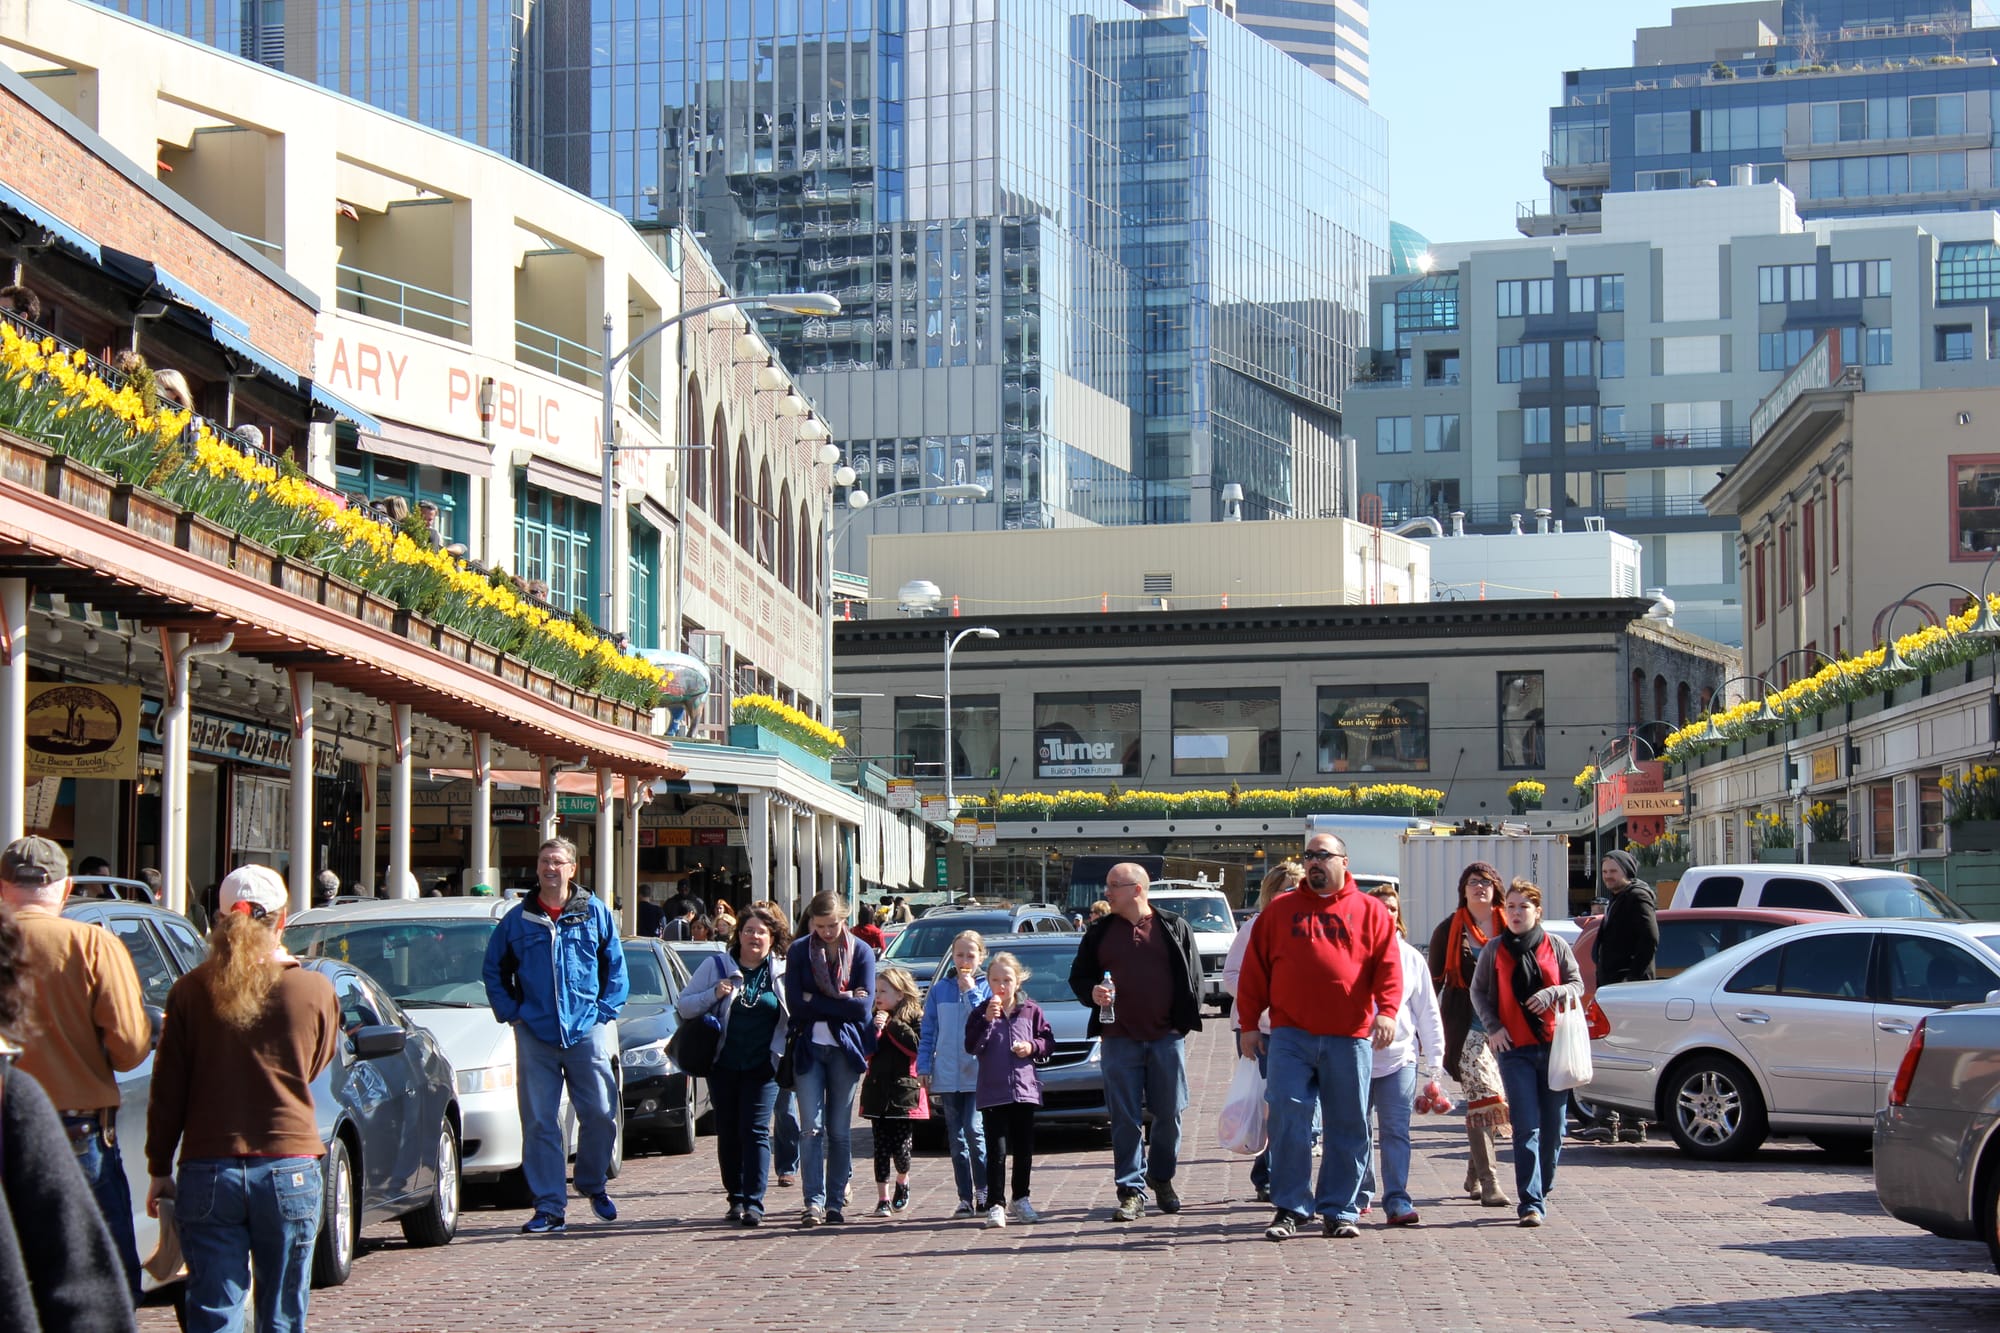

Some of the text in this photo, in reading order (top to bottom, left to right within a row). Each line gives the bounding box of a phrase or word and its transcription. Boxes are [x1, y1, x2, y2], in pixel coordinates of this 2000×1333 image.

[448, 367, 561, 446] PUBLIC
[239, 725, 345, 777] DELIIES
[1043, 738, 1115, 761] Turner
[34, 754, 102, 766] La Buena Tavola
[1050, 767, 1077, 775] Building
[1091, 766, 1112, 774] Future
[570, 798, 596, 812] Alley
[690, 815, 734, 826] PUBLIC
